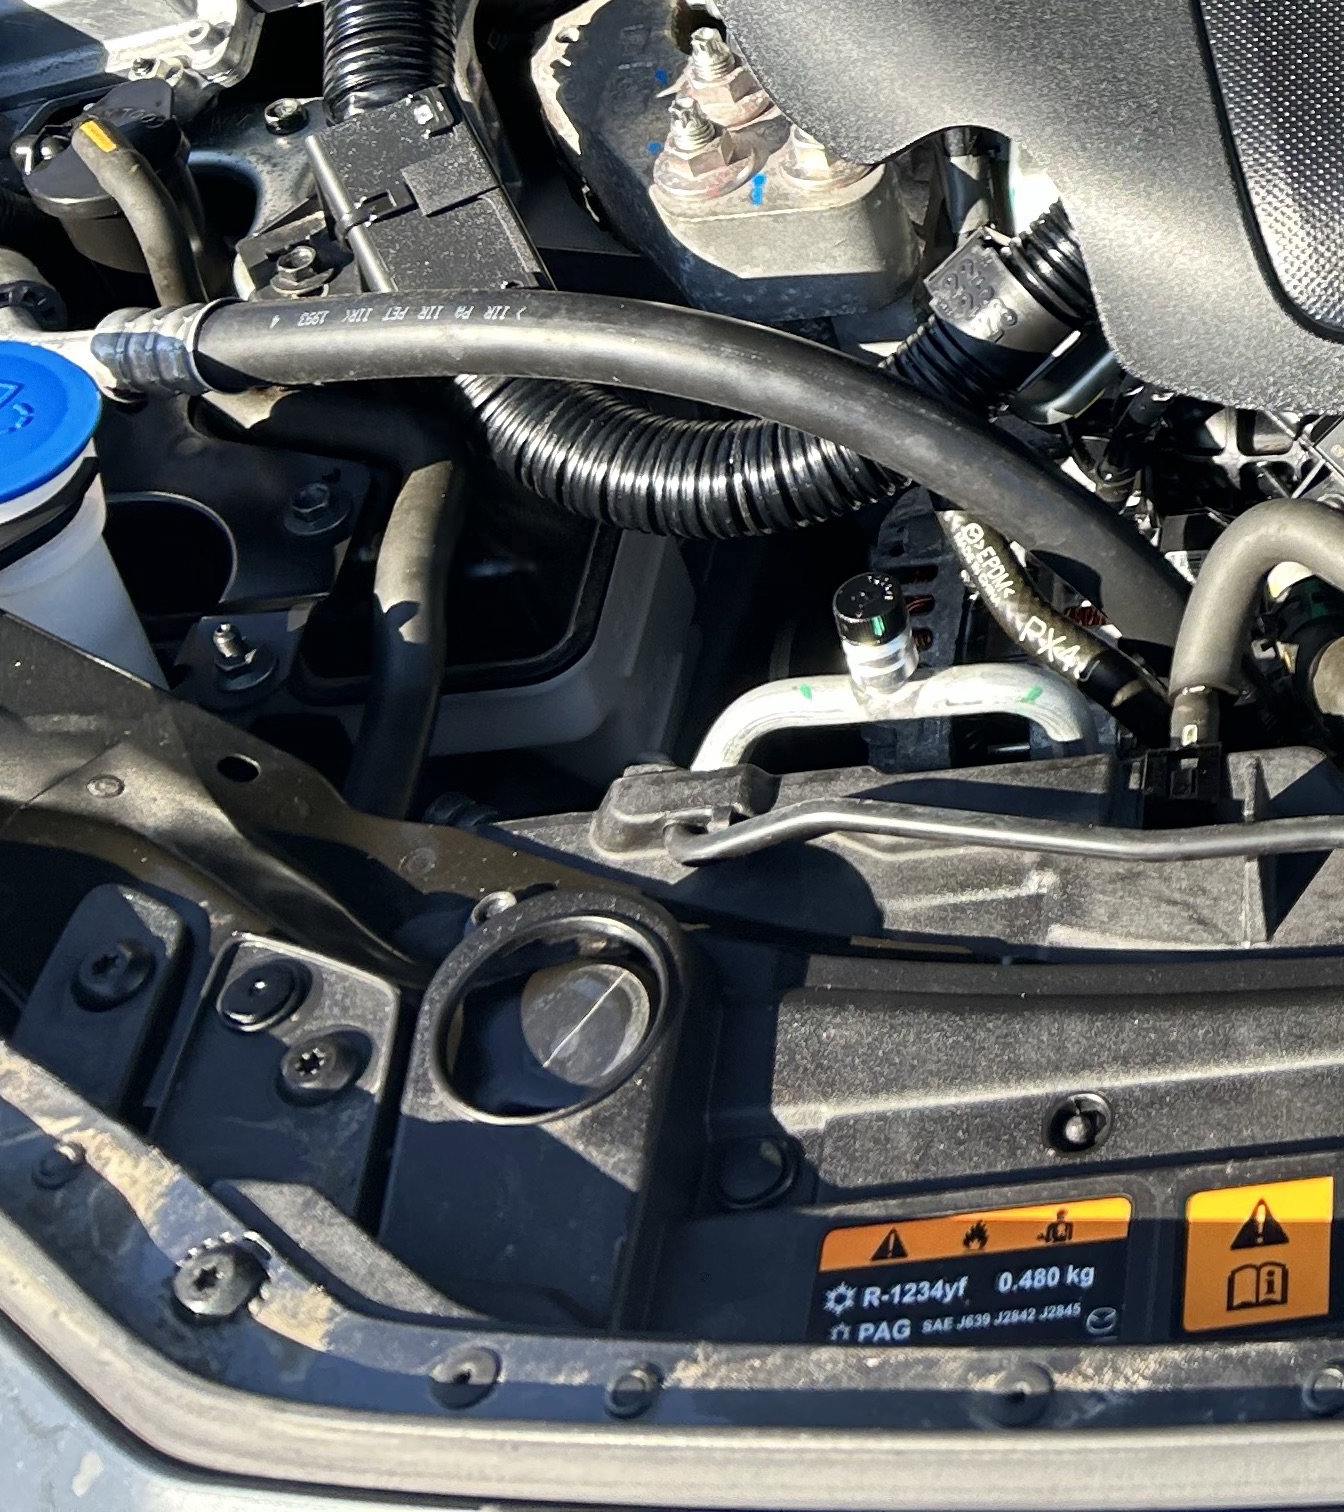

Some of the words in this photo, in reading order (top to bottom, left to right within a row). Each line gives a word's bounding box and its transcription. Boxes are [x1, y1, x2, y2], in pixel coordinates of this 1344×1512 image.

[862, 1275, 969, 1309] R-1234yf
[997, 1269, 1061, 1294] 0.480
[1065, 1264, 1096, 1290] kg
[857, 1318, 912, 1343] PAG
[921, 1316, 954, 1335] SAE
[957, 1311, 991, 1330] J639
[993, 1307, 1036, 1327] J2842
[1038, 1301, 1083, 1321] J2845
